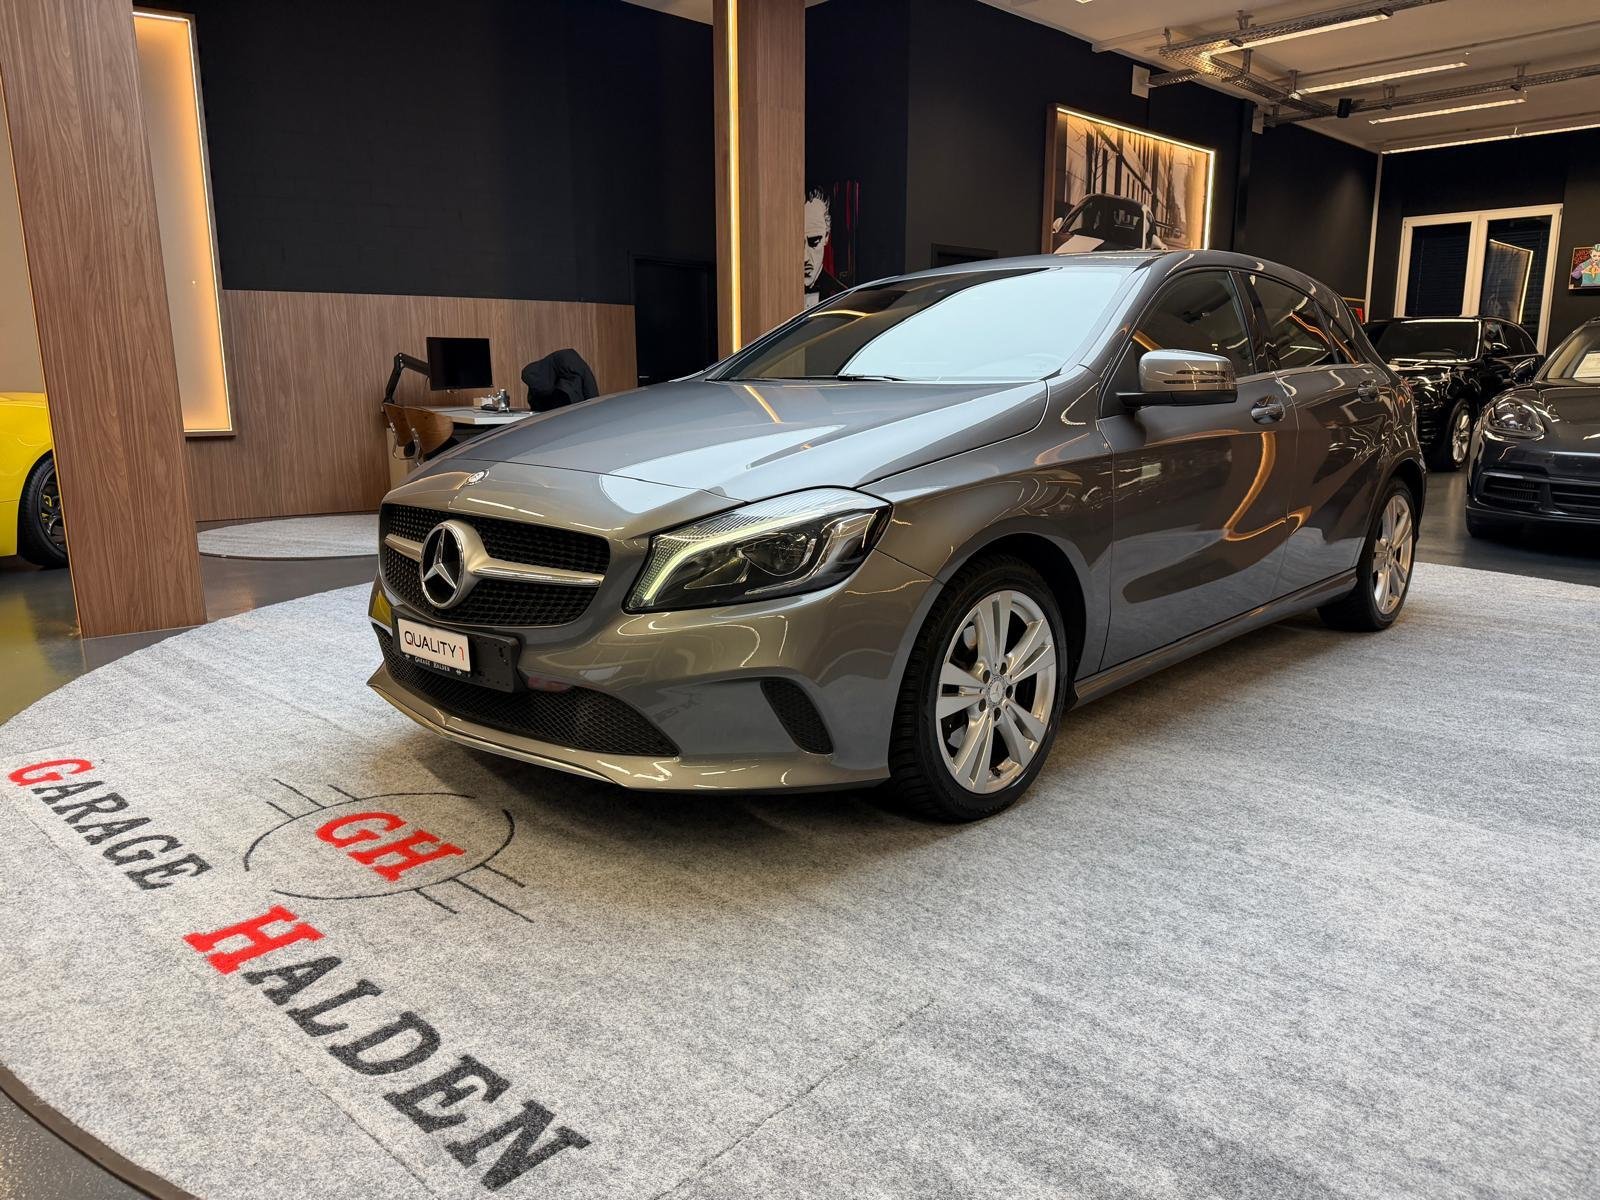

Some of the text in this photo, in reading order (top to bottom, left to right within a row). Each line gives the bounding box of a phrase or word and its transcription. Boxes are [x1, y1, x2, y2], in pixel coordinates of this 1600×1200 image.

[404, 631, 464, 661] QUALITY 1
[8, 758, 212, 890] GARAGE
[315, 811, 466, 882] GH
[183, 905, 591, 1190] HALDEN
